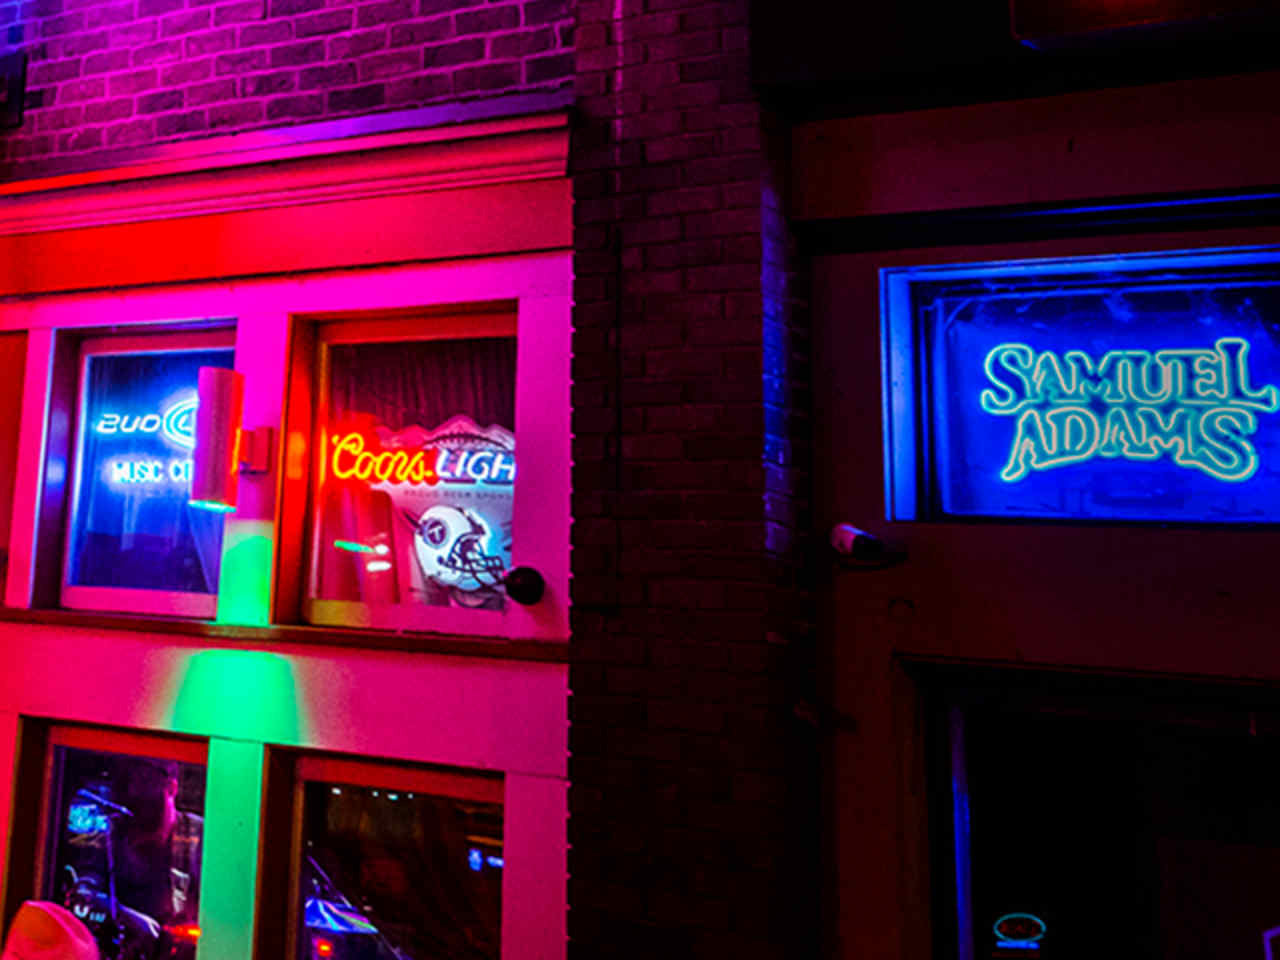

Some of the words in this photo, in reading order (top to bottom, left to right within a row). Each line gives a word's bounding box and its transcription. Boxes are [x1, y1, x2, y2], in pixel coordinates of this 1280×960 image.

[980, 337, 1279, 415] SAMUEL
[112, 460, 163, 484] MUSIC
[167, 460, 194, 484] CI
[332, 432, 434, 481] Coors
[435, 447, 516, 480] LIGH
[999, 405, 1259, 482] ADAMS
